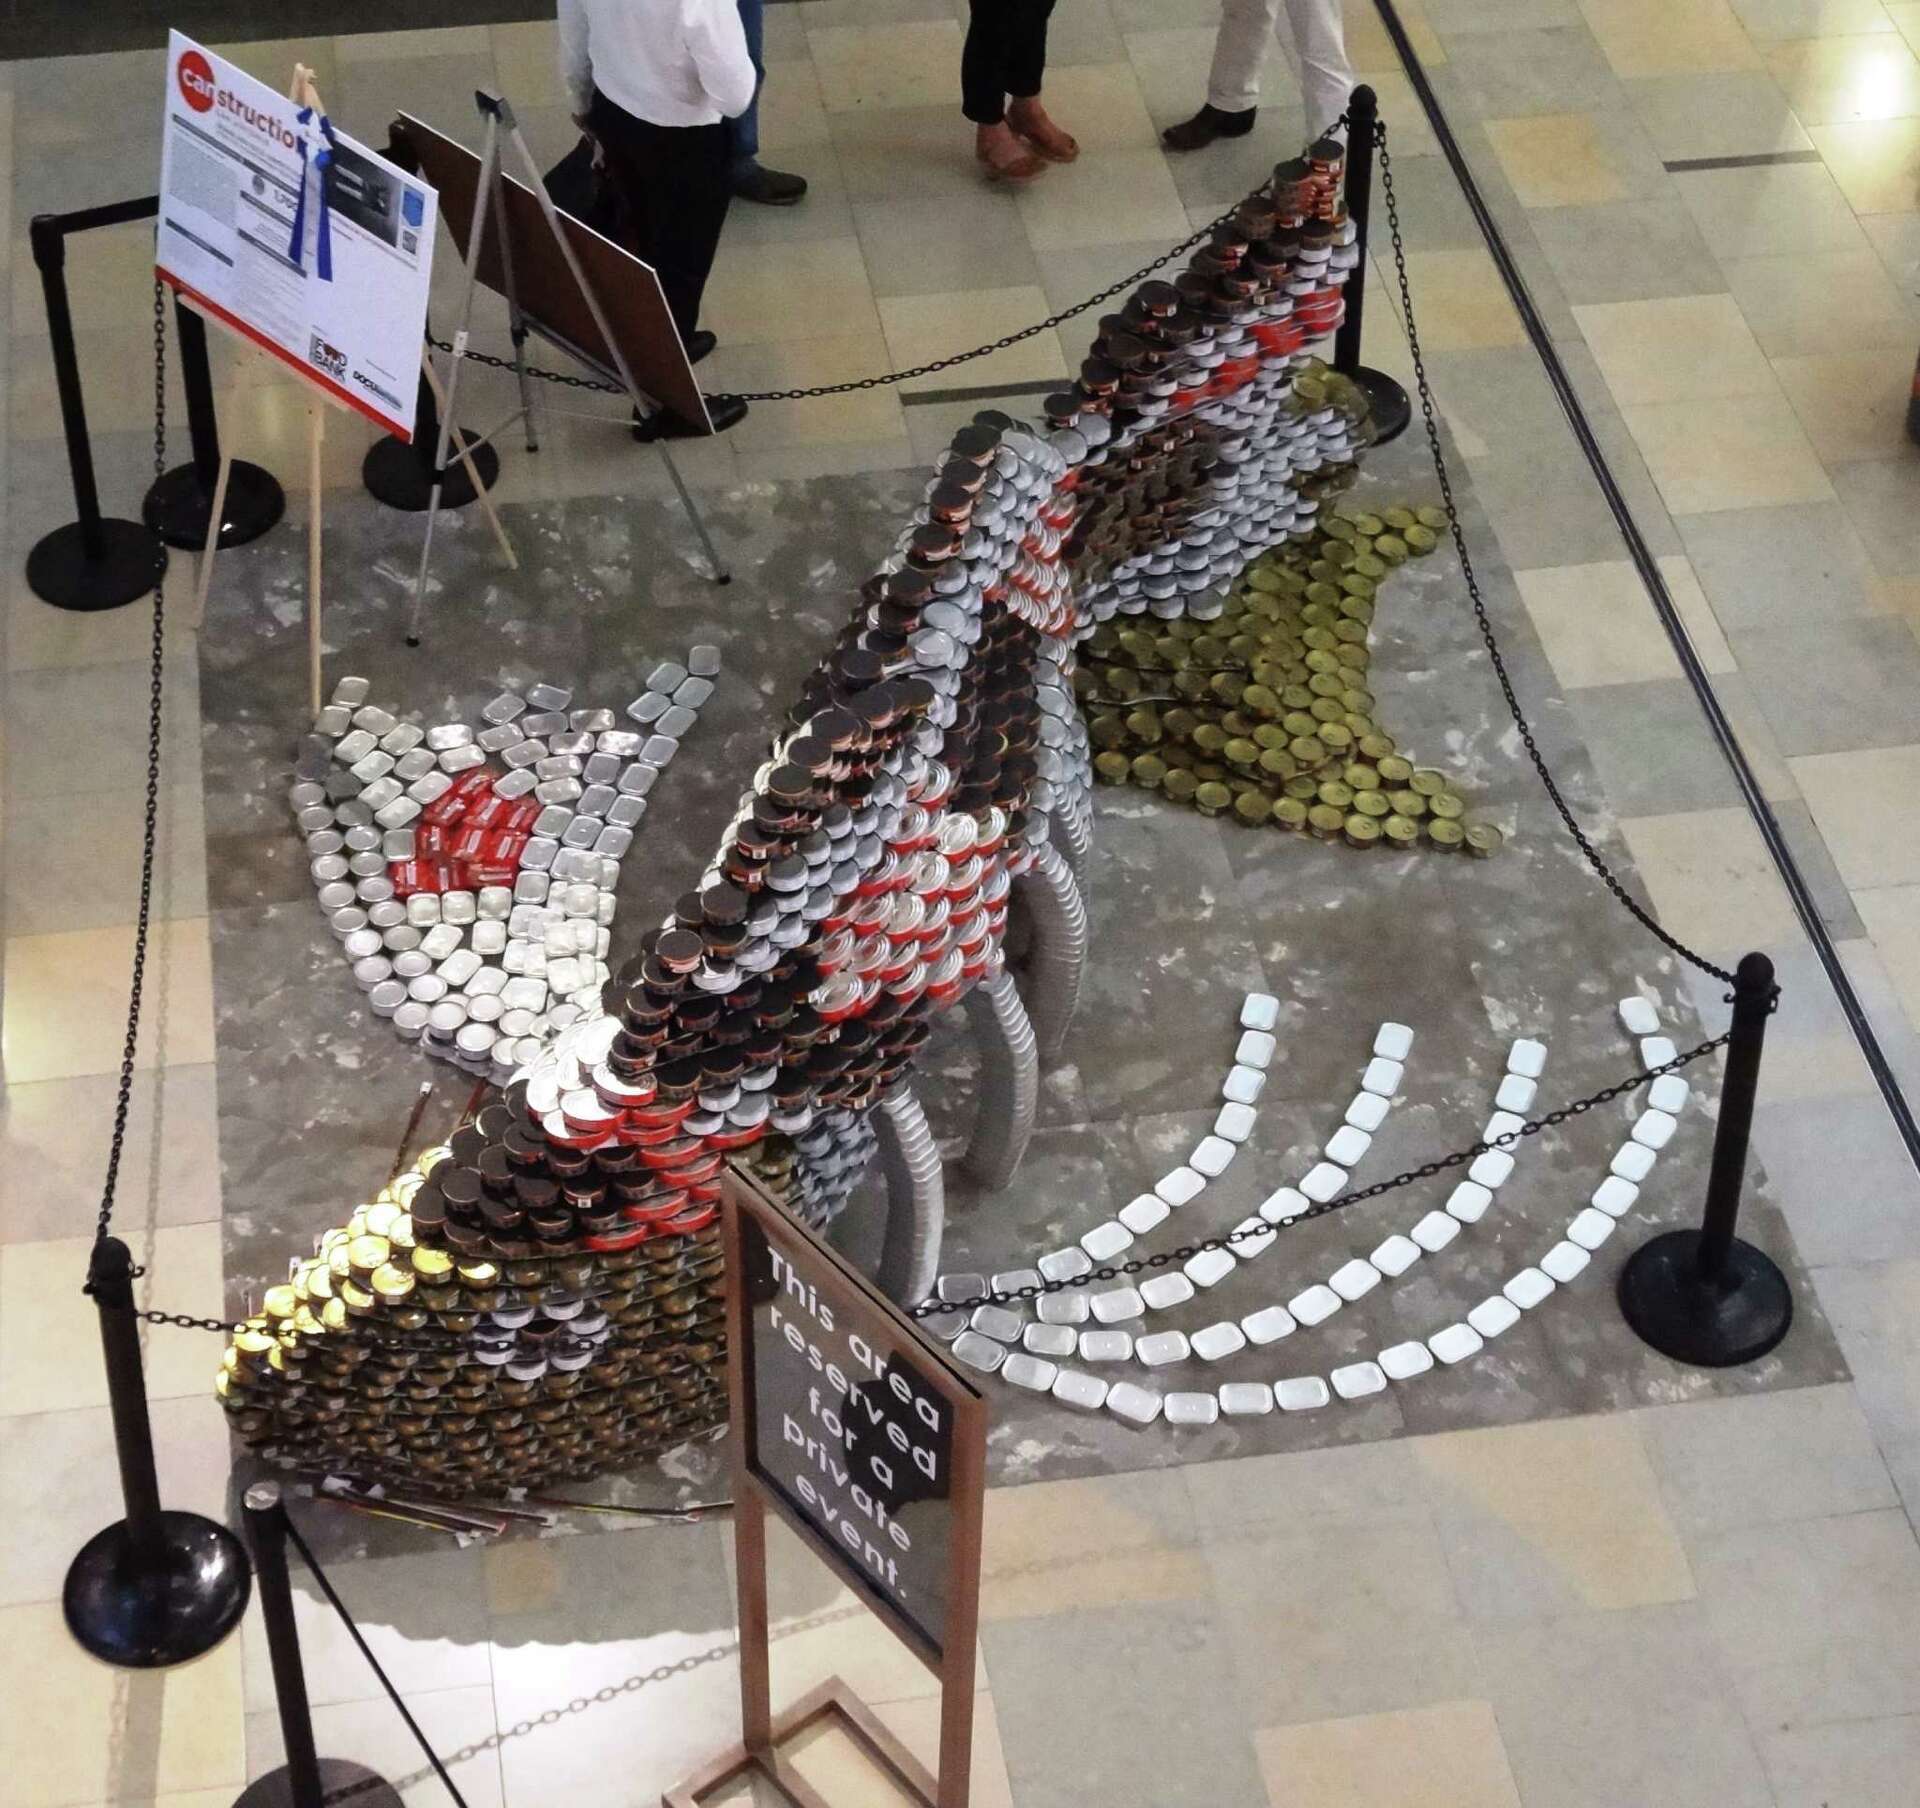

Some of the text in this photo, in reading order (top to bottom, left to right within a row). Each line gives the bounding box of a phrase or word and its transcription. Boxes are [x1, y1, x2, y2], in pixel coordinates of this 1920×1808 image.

[182, 68, 295, 149] canstructio
[768, 1246, 940, 1433] This area
[770, 1305, 937, 1482] reserved
[783, 1413, 911, 1553] private
[808, 1385, 894, 1491] for a
[796, 1474, 908, 1600] event.
